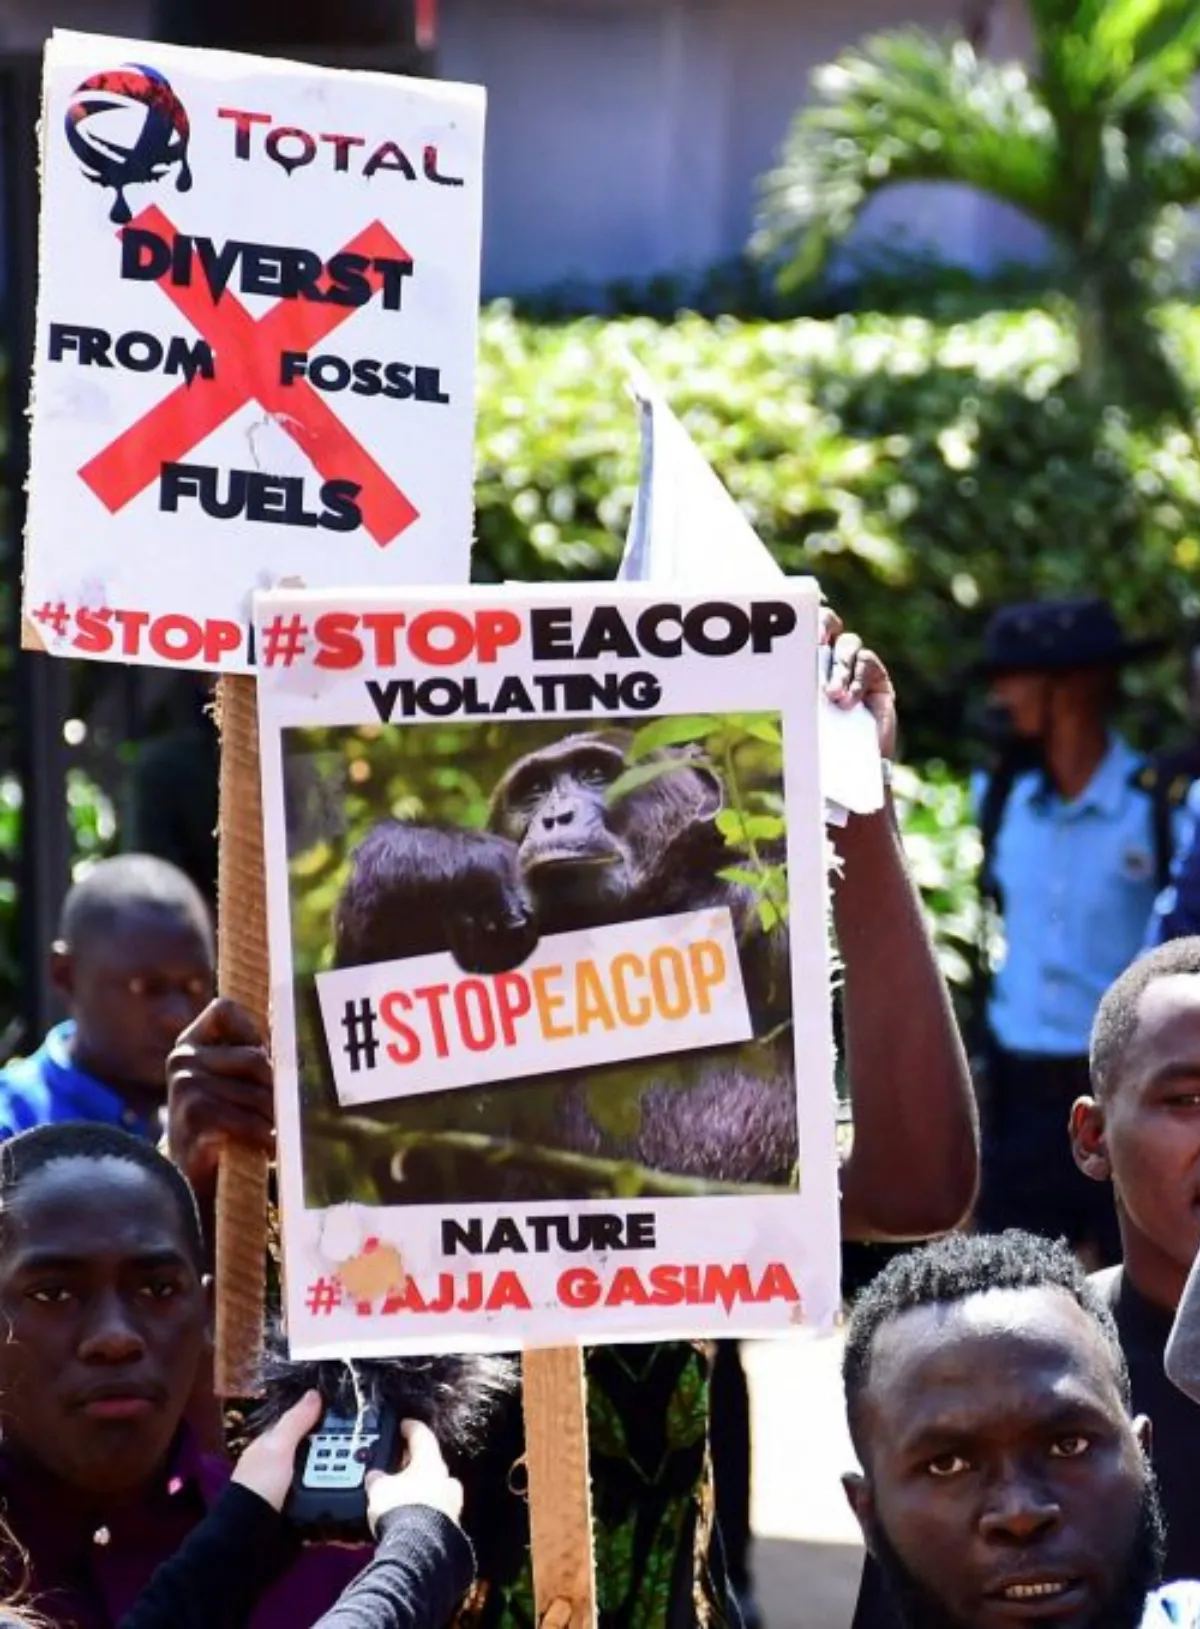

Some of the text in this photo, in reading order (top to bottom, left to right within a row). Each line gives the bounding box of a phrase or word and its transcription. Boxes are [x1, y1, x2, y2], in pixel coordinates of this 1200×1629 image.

[218, 107, 464, 186] TOTAL
[121, 228, 413, 310] DIVERST
[48, 323, 214, 391] FROM
[160, 462, 363, 533] FUELS
[366, 671, 661, 722] VIOLATING
[341, 938, 726, 1072] #STOPEACOP
[441, 1213, 657, 1255] NATURE
[305, 1263, 800, 1317] #AJJA GASIMA
